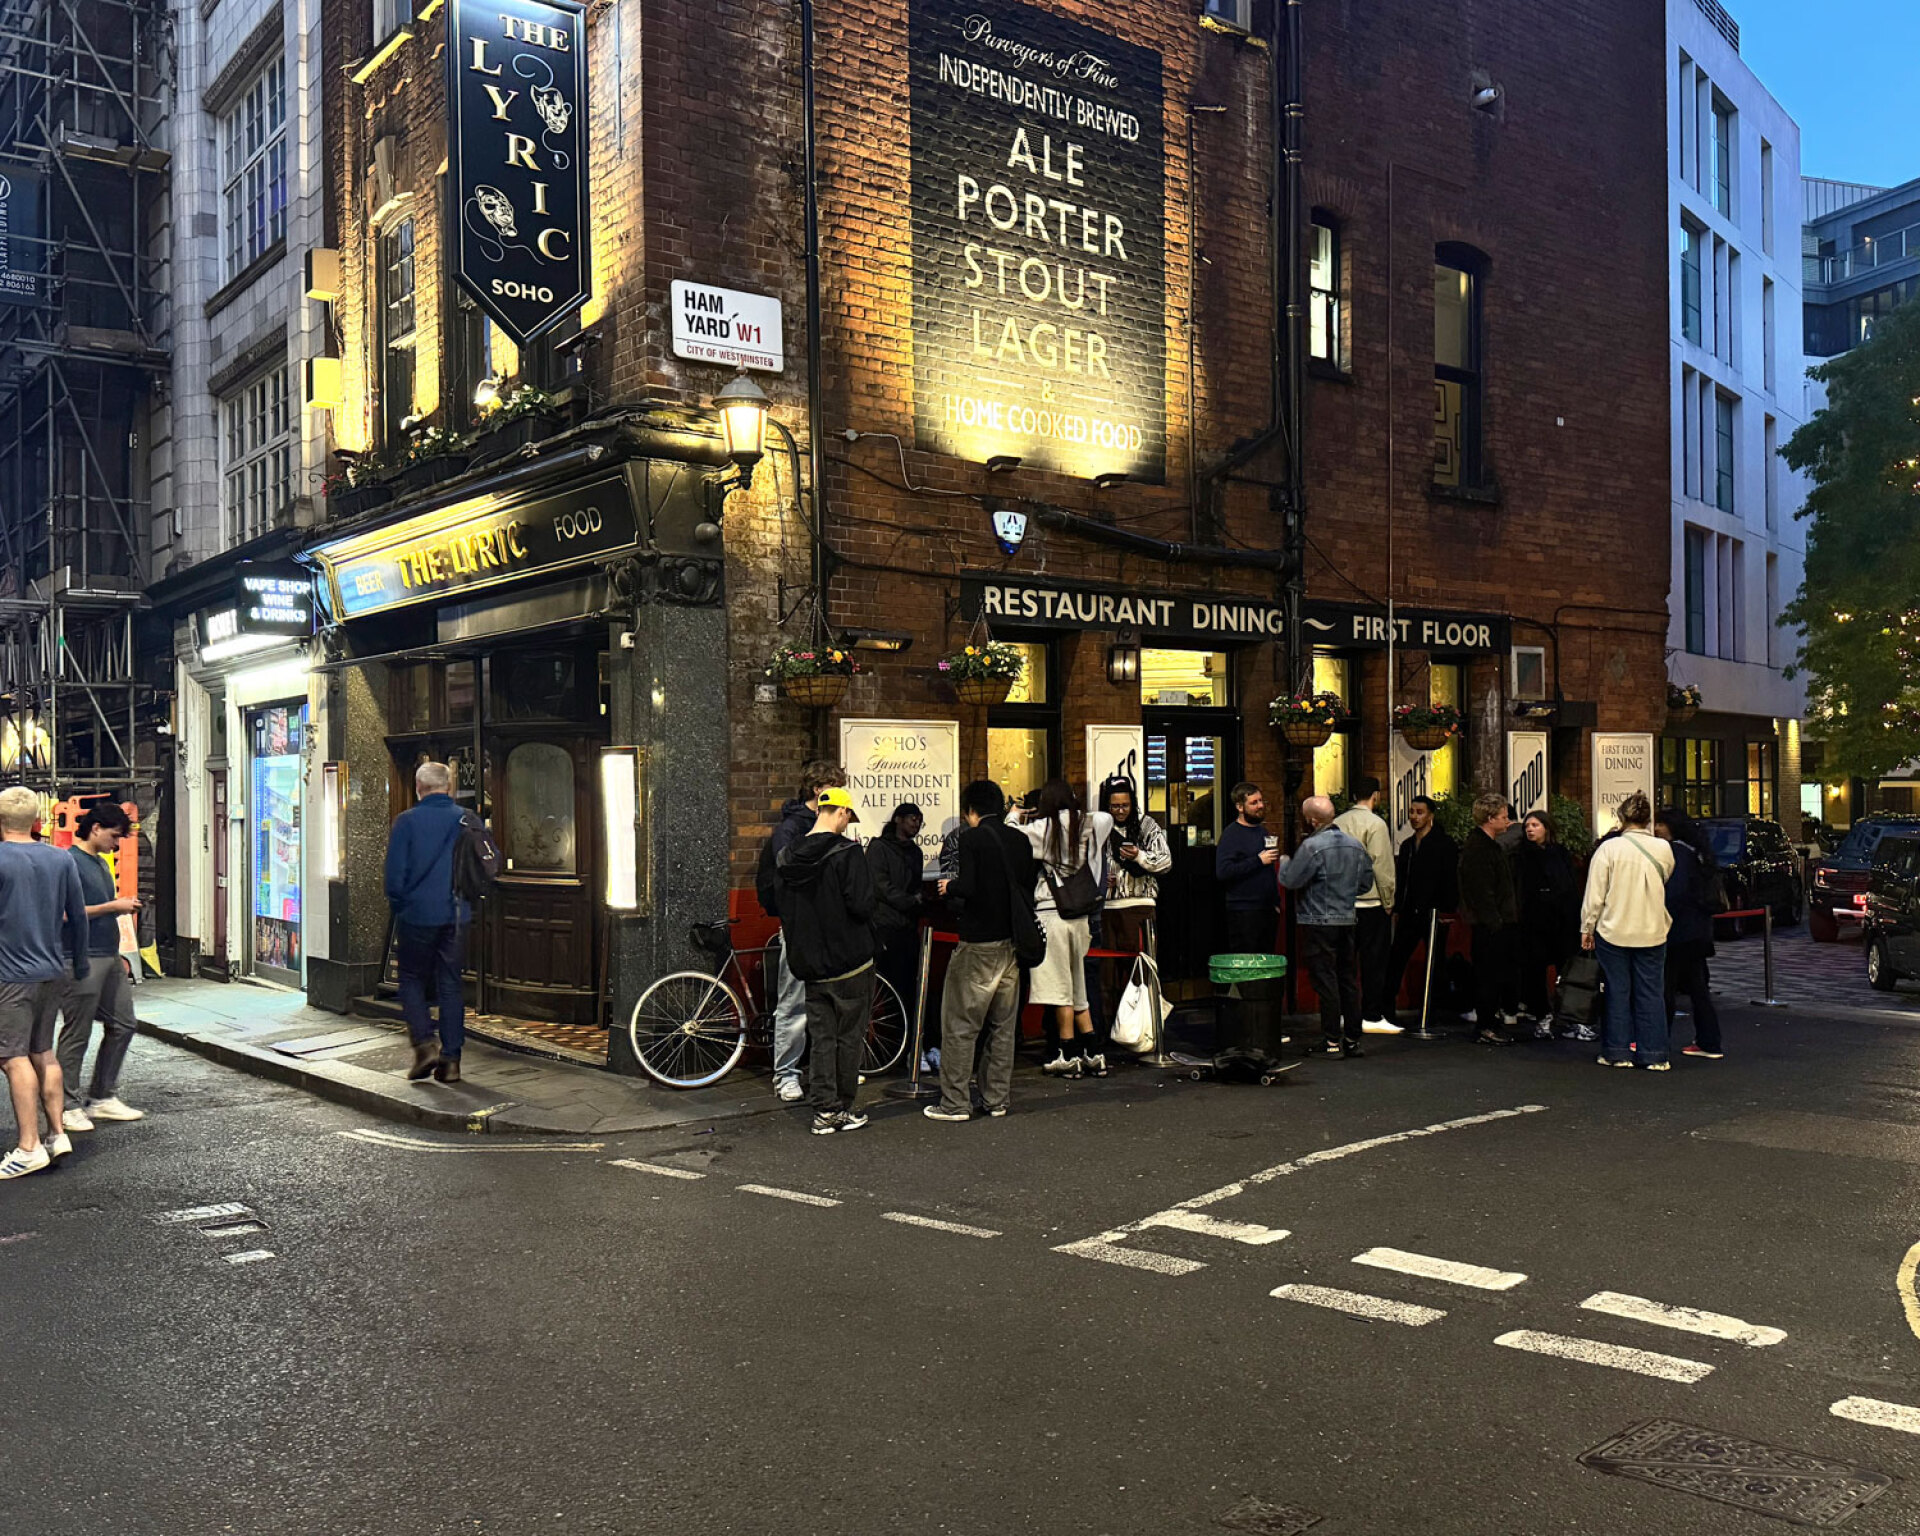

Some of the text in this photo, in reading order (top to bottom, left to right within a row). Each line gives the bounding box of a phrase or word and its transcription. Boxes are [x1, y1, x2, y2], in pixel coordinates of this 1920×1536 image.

[499, 14, 569, 52] THE
[962, 14, 1120, 89] Purveyors of Fine
[939, 52, 1140, 142] INDEPENDENTLY BREWED
[469, 37, 572, 261] LYRIC
[1007, 128, 1084, 187] ALE
[958, 174, 1128, 261] PORTER
[491, 278, 554, 303] SOHO
[964, 243, 1117, 316] STOUT
[684, 289, 724, 315] HAM
[684, 313, 761, 344] YARD W1
[973, 310, 1111, 379] LAGER
[687, 345, 774, 367] CITY OF WESTMINSTER
[1041, 380, 1056, 403] &
[945, 394, 1142, 451] HOME COOKED FOOD
[356, 571, 385, 596] BEER
[553, 507, 603, 542] FOOD
[244, 578, 311, 594] VAPE SHOP
[261, 593, 294, 607] WINE
[250, 607, 306, 623] & DRINKS
[984, 585, 1491, 647] RESTAURANT DINING FIRST FLOOR
[867, 755, 927, 773] Famous
[1601, 745, 1644, 755] FIRST FLOOR
[1604, 757, 1643, 770] DINING
[847, 774, 952, 789] INDEPENDENT
[1396, 755, 1426, 831] CIDER
[1512, 750, 1542, 820] FOOD
[861, 792, 941, 808] ALE HOUSE
